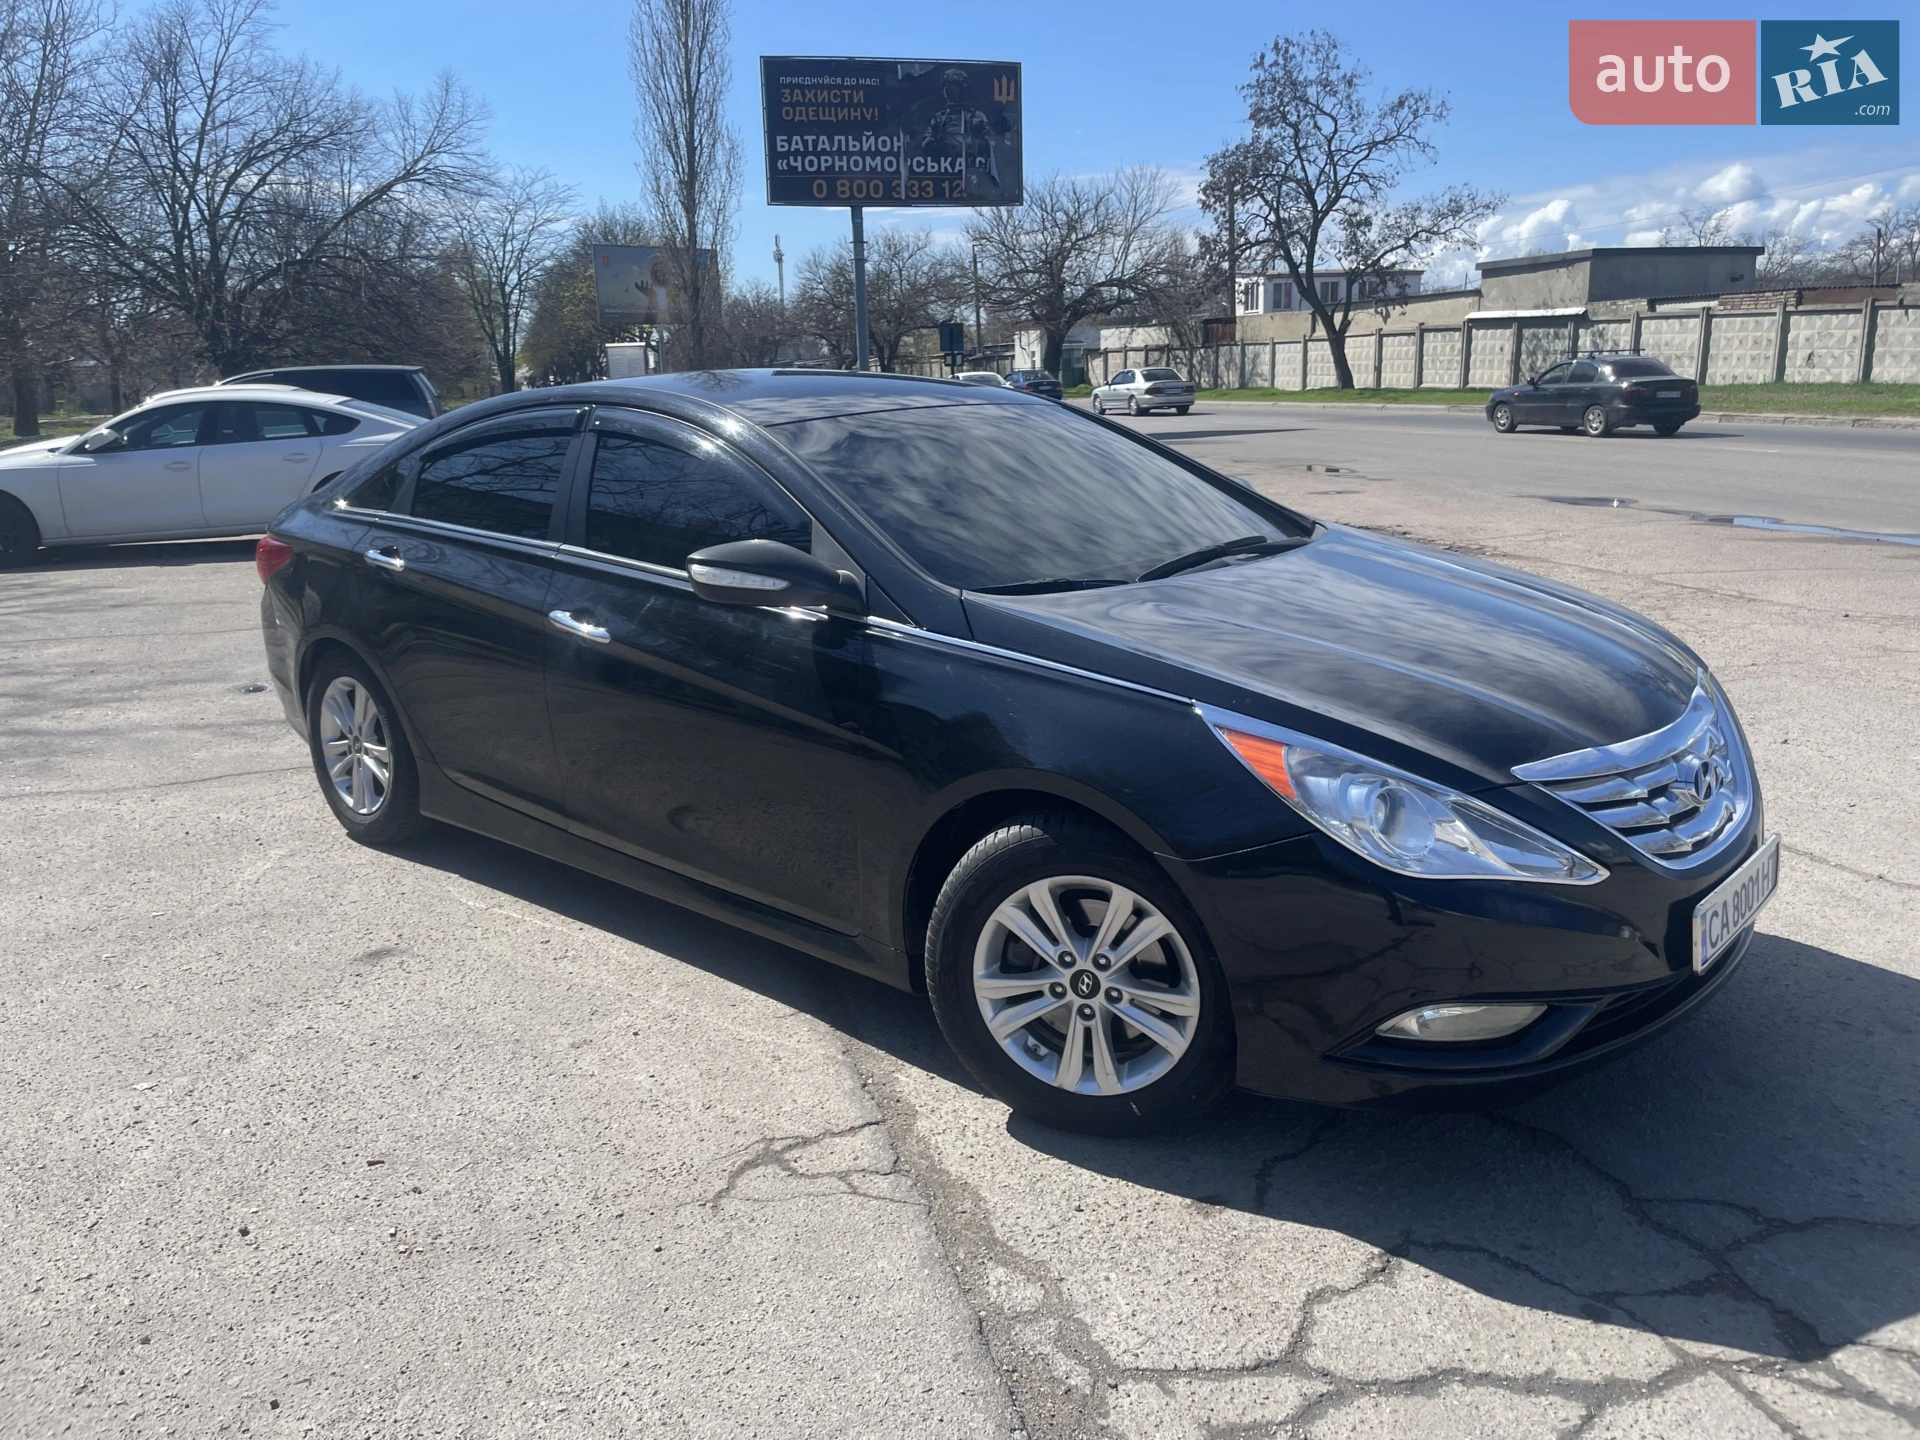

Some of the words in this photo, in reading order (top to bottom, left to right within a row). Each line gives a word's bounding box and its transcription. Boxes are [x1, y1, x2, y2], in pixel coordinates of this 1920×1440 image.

[779, 75, 842, 85] ПРИЄДНУЙСЯ
[844, 77, 857, 86] ДО
[859, 77, 880, 86] НАС!
[780, 88, 865, 104] ЗАХИСТИ
[781, 106, 879, 122] ОДЕЩИНУ!
[812, 179, 827, 198] 0
[836, 179, 884, 198] 800
[891, 179, 934, 198] 333
[1708, 899, 1730, 949] CA
[1732, 867, 1760, 928] 8001
